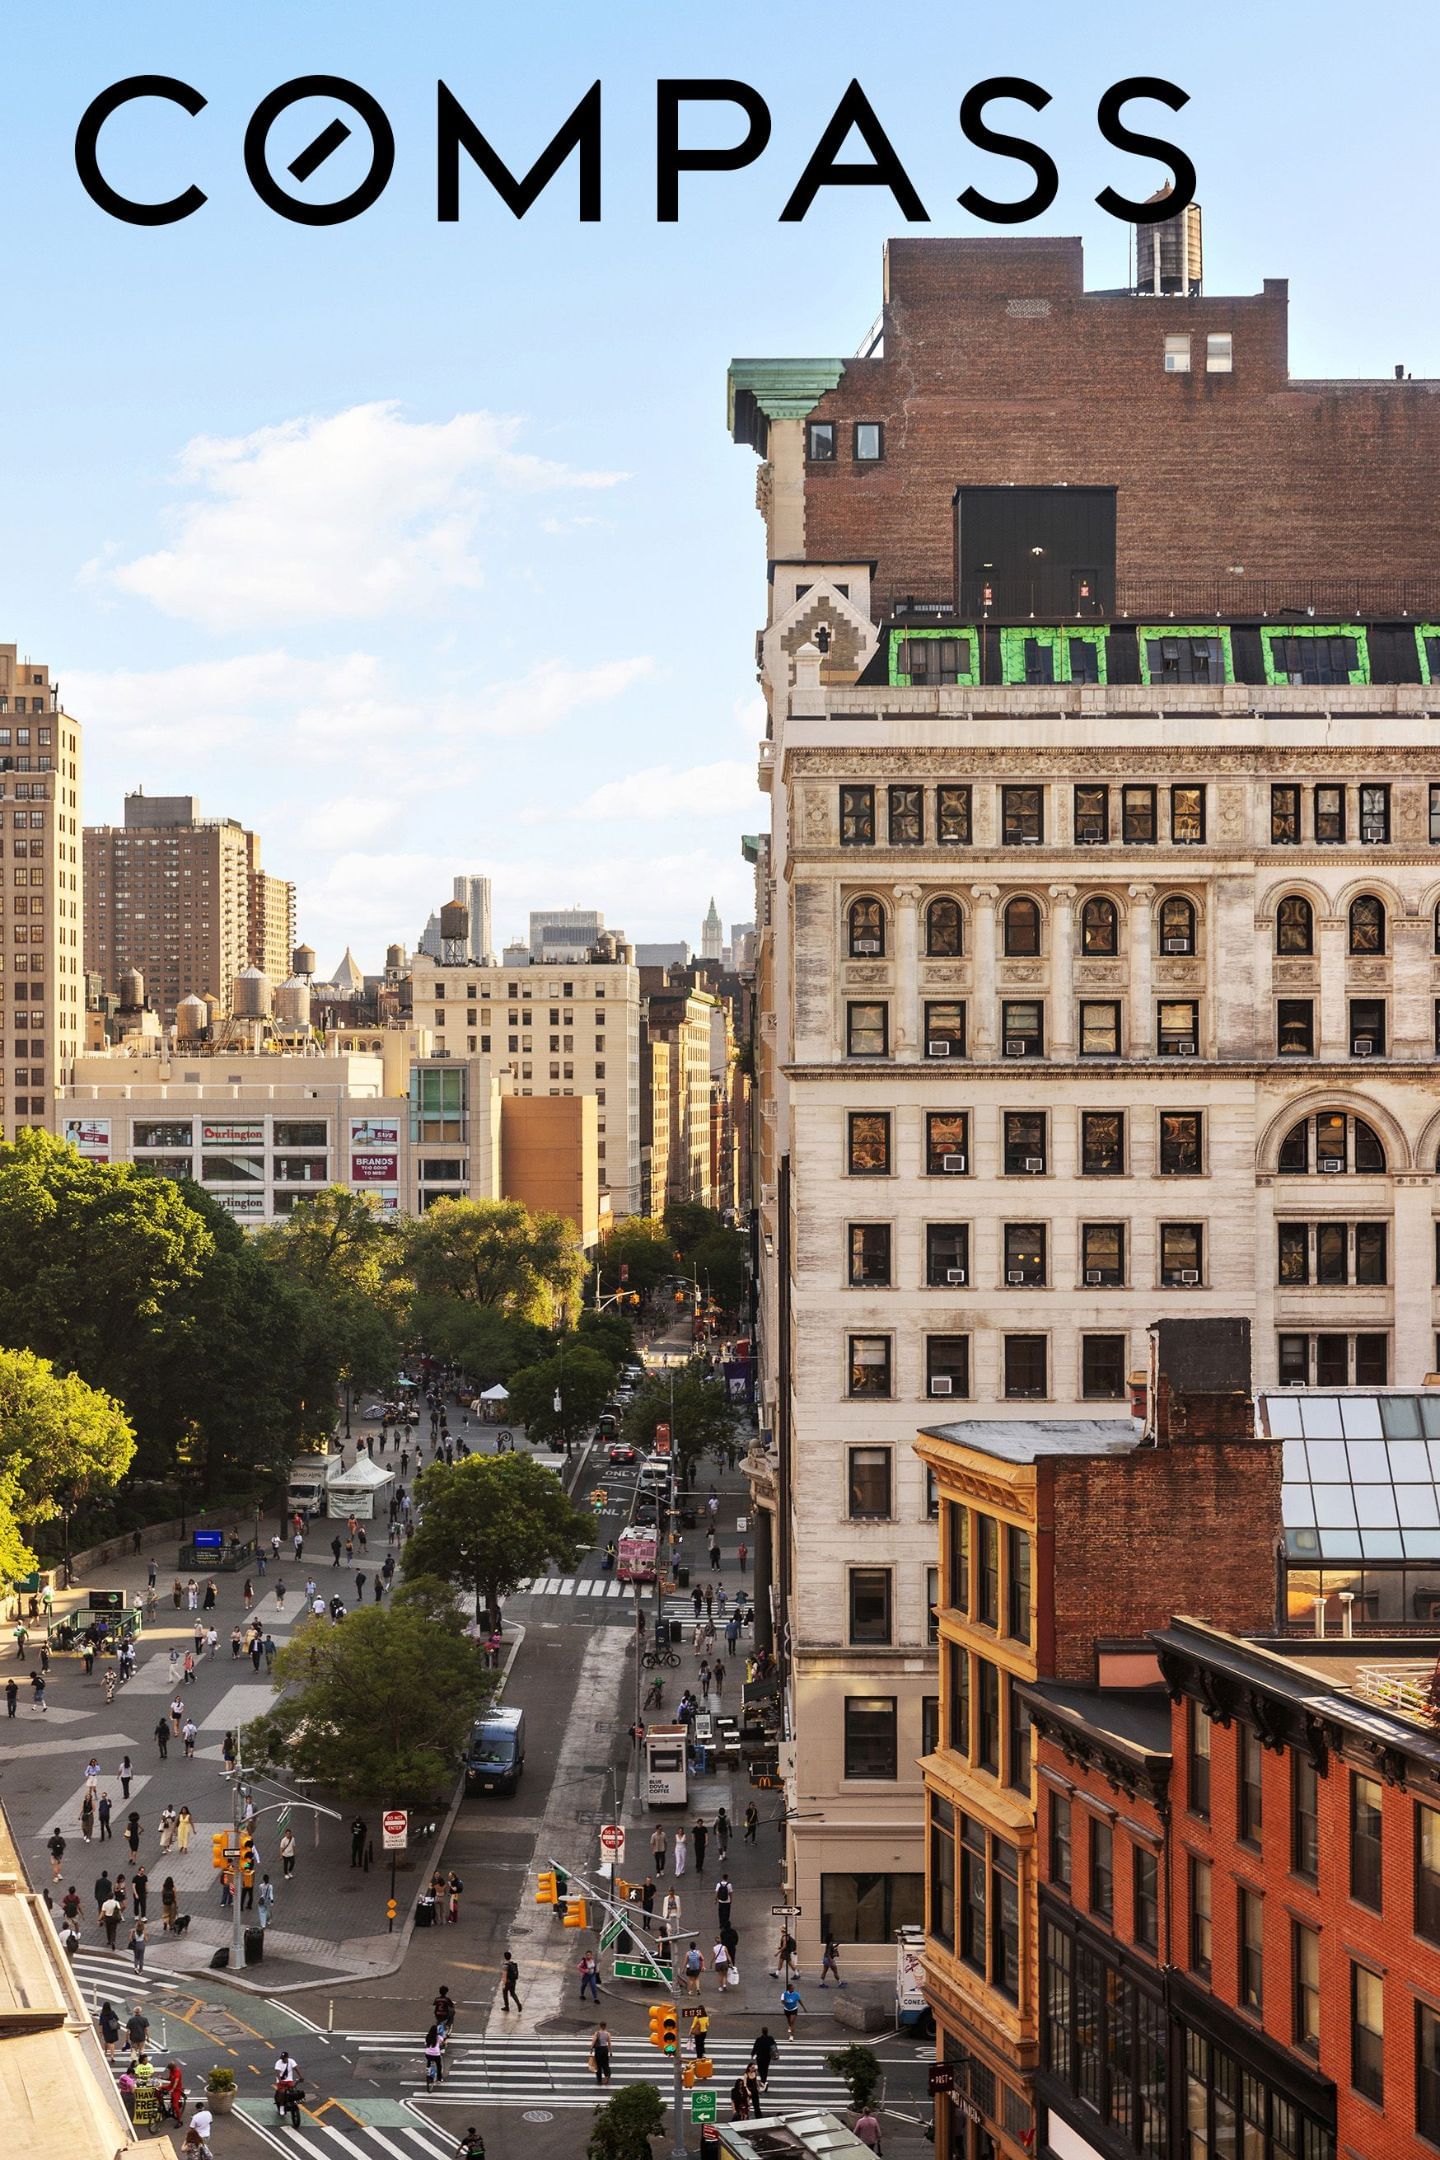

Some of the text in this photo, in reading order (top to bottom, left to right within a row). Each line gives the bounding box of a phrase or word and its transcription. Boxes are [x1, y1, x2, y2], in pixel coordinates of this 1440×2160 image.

[204, 1128, 263, 1141] Burlington
[592, 1508, 630, 1516] ONLY
[631, 1966, 662, 1978] E 17 S
[135, 2100, 158, 2110] FREE
